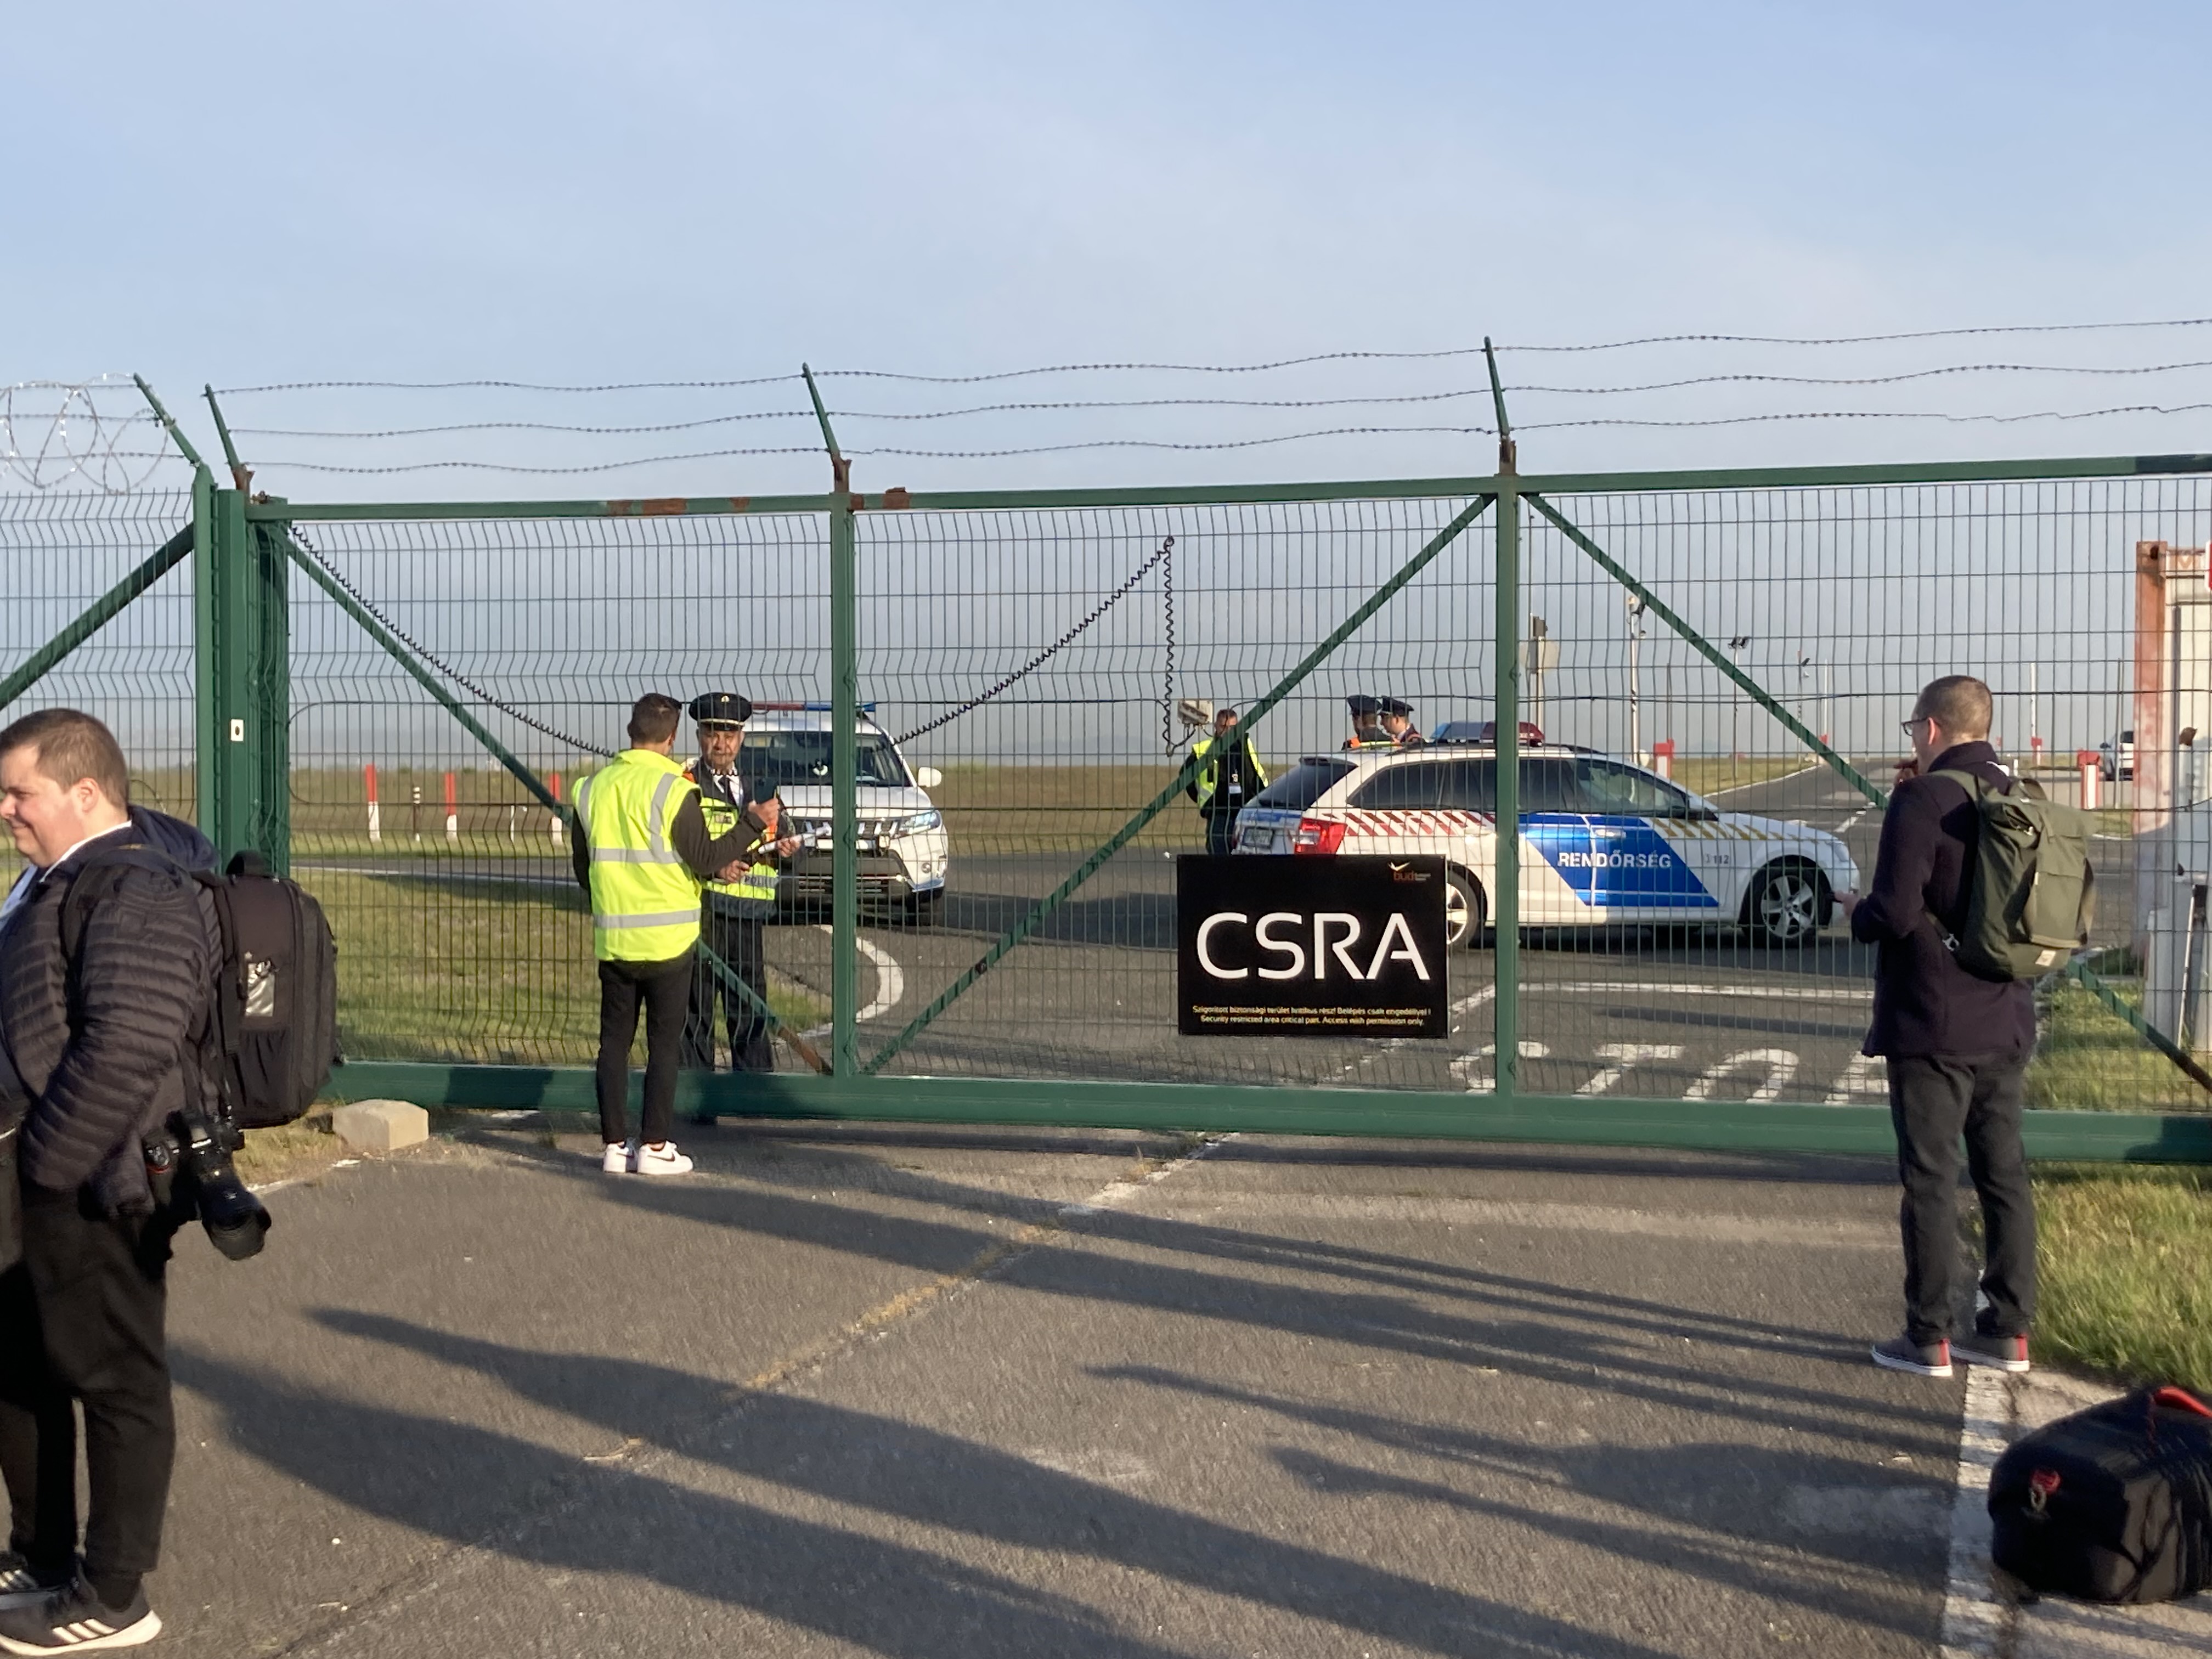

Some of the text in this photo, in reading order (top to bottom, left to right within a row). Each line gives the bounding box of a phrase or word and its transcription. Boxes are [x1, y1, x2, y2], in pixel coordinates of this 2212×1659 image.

[1557, 849, 1671, 868] RENDŐRSÉG
[744, 875, 776, 888] POLI
[1196, 912, 1430, 980] CSRA
[1200, 1015, 1229, 1024] Security
[1366, 1018, 1406, 1026] permission
